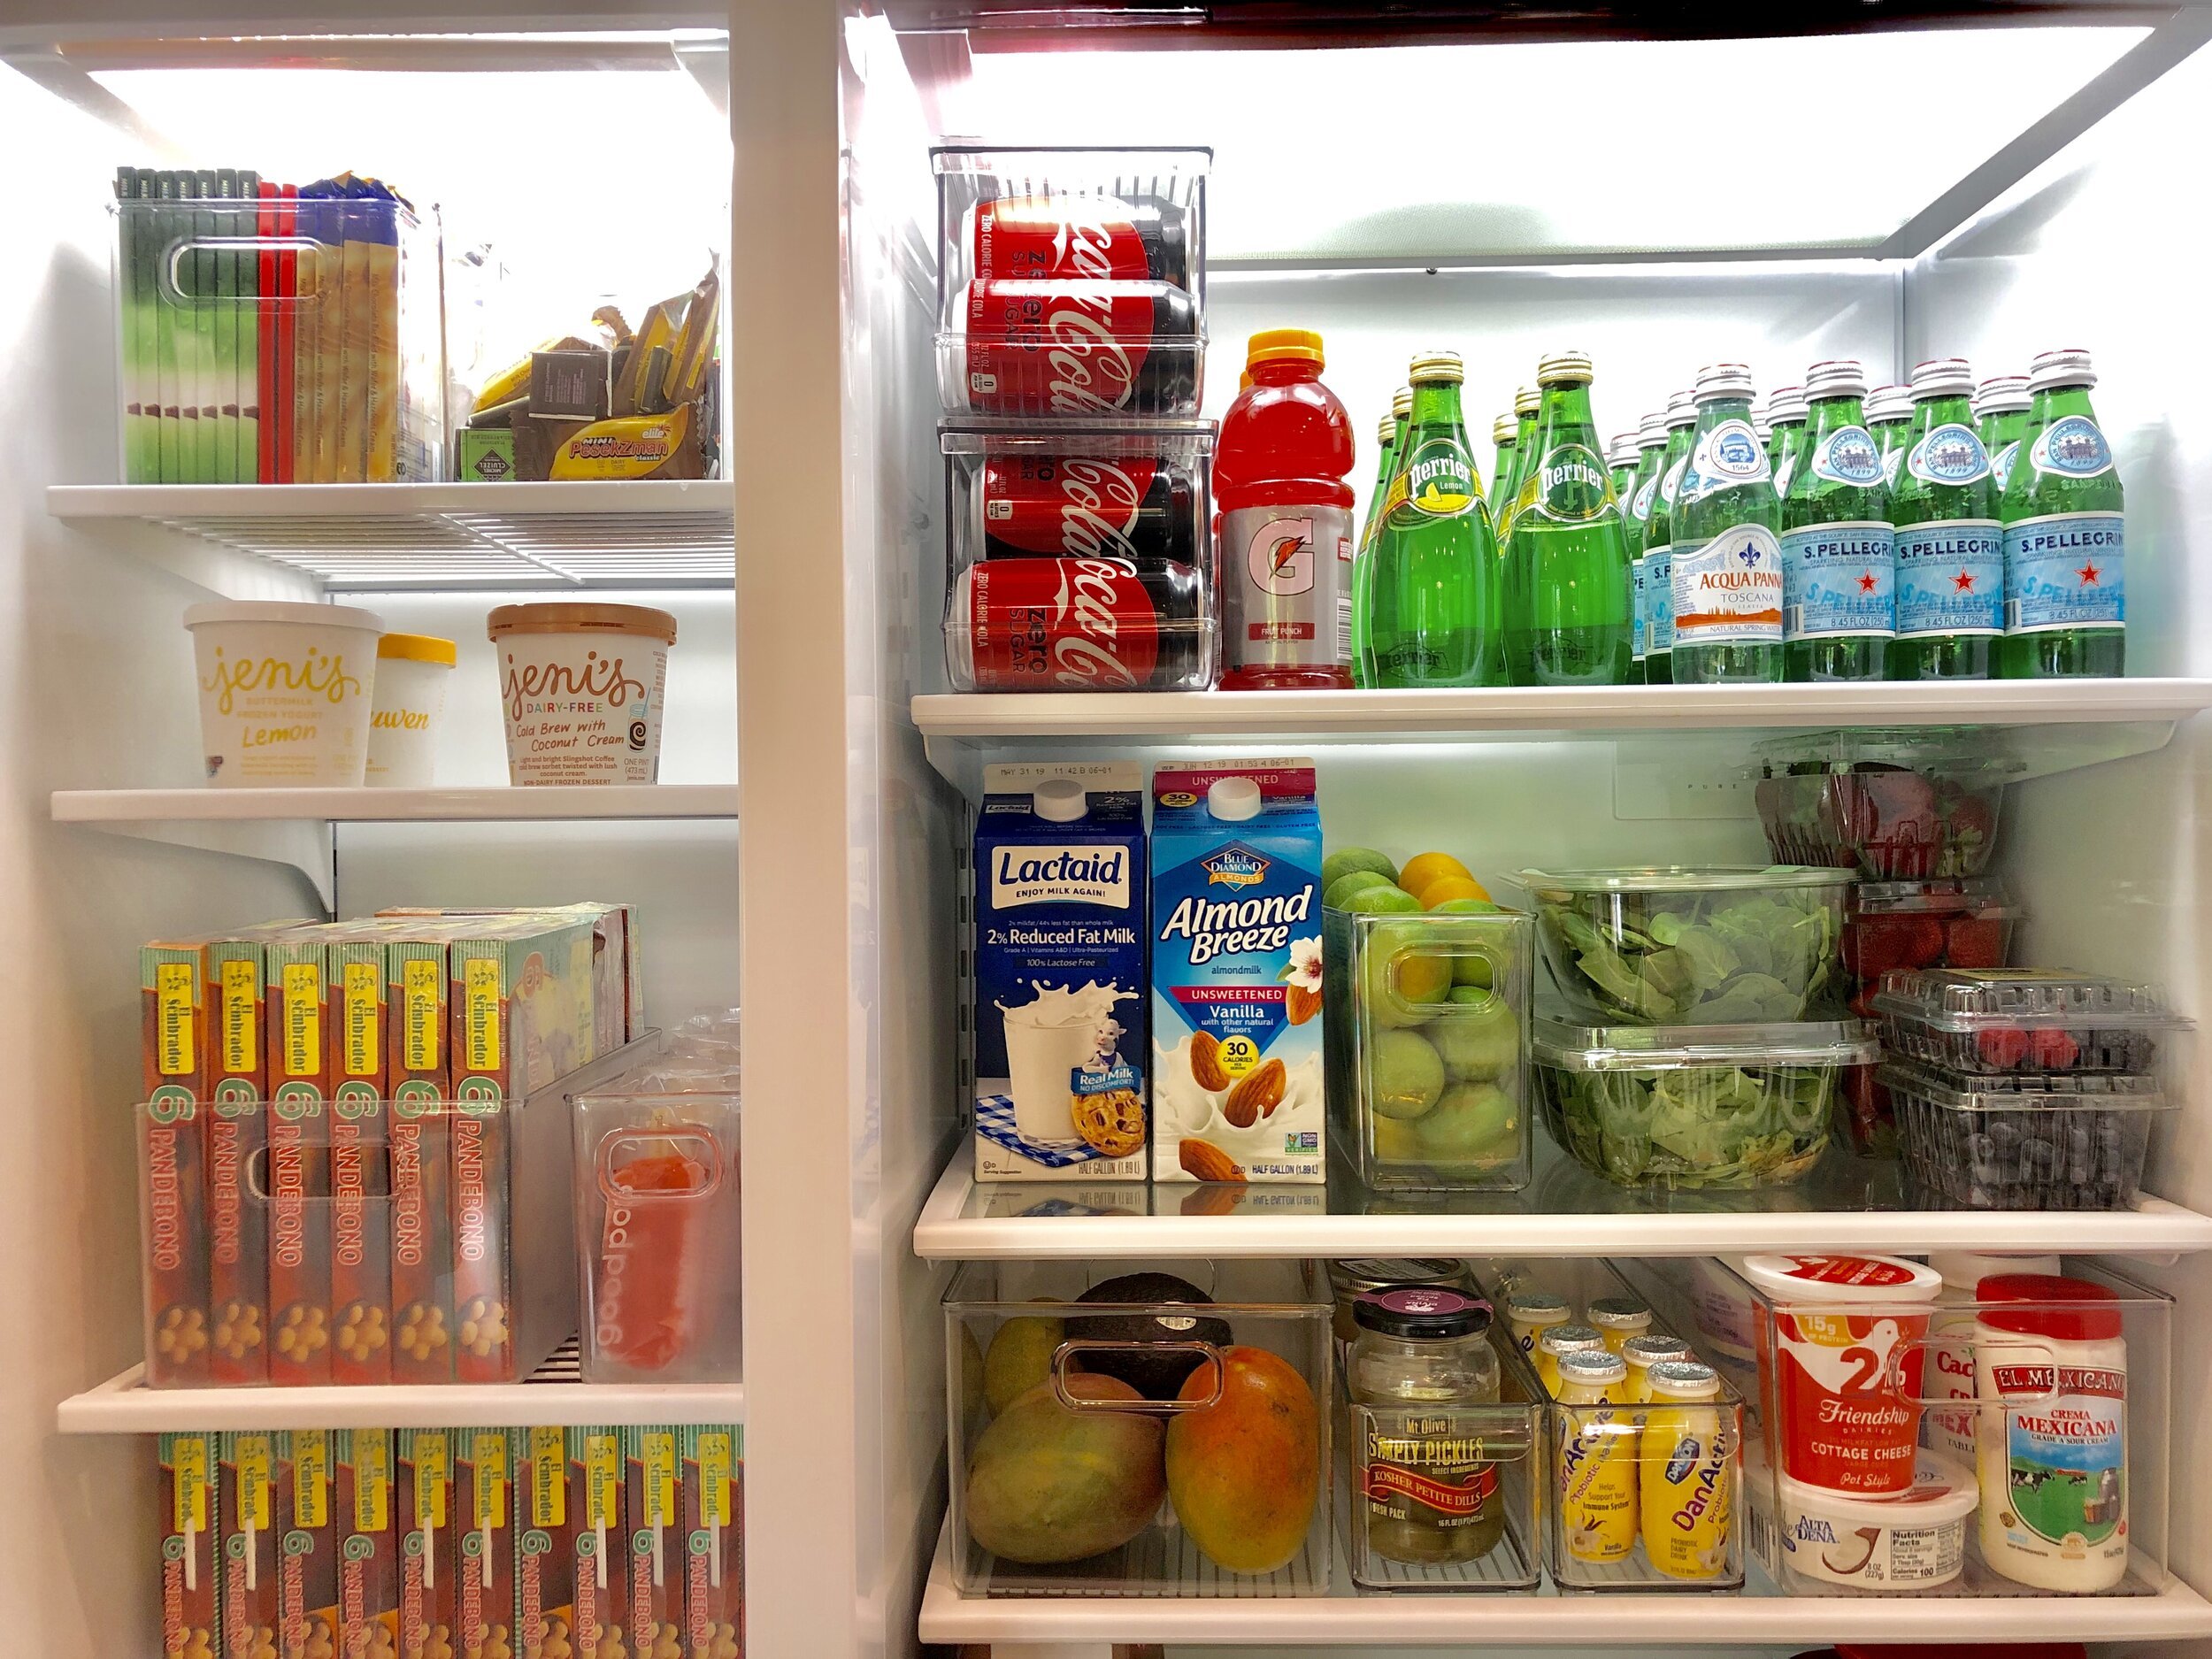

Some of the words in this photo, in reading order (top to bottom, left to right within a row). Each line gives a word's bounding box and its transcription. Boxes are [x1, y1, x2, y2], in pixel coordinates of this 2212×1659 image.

[981, 215, 993, 233] ZERO
[981, 234, 992, 267] CALORIE
[1248, 518, 1315, 596] G
[977, 572, 989, 589] ZERO
[1700, 572, 1751, 590] ACQUA
[1754, 572, 1782, 588] PANN
[1721, 594, 1774, 603] TOSCANA
[1859, 616, 1870, 626] OZ
[977, 626, 989, 648] COLA
[1009, 608, 1025, 672] SUGAR
[1027, 608, 1048, 674] zero
[200, 646, 361, 715] jeni's
[503, 651, 645, 721] jeni's
[526, 703, 603, 714] DAIRY-FREE
[242, 726, 317, 749] Lemon
[516, 723, 535, 738] Cold
[541, 722, 571, 734] Brew
[577, 719, 606, 733] with
[531, 737, 579, 752] Coconut
[588, 736, 625, 747] Cream
[1210, 863, 1262, 872] DIAMOND
[1224, 854, 1249, 864] BLUE
[999, 851, 1122, 886] Lactaid
[1213, 873, 1261, 883] ALMONDS
[1016, 888, 1044, 898] ENJOY
[1073, 888, 1106, 897] AGAIN!
[1160, 885, 1313, 940] Almond
[987, 929, 1008, 945] 2%
[1010, 928, 1074, 944] Reduced
[1078, 929, 1101, 944] Fat
[1104, 928, 1135, 943] Milk
[1190, 926, 1288, 964] Breeze
[1048, 958, 1078, 967] Lactose
[1211, 965, 1262, 975] almondmilk
[1191, 989, 1282, 1000] UNSWEETENED
[1210, 1005, 1264, 1018] Vanilla
[165, 998, 180, 1071] Sembrador
[229, 995, 243, 1069] Sembrador
[290, 998, 306, 1071] Sembrador
[411, 994, 426, 1069] Sembrador
[472, 994, 488, 1068] Sembrador
[1226, 1042, 1248, 1056] 30
[1079, 1074, 1106, 1086] Real
[1108, 1068, 1133, 1079] Milk
[1079, 1161, 1092, 1175] HALF
[1093, 1161, 1116, 1175] GALLON
[275, 1125, 303, 1267] PANDEBONO
[334, 1125, 363, 1266] PANDEBONO
[457, 1120, 485, 1261] PANDEBONO
[2001, 1370, 2025, 1387] EL
[1819, 1400, 1909, 1427] Friendship
[2050, 1409, 2092, 1420] CREMA
[1422, 1418, 1446, 1434] Olive
[2017, 1415, 2117, 1437] MEXICANA
[2032, 1433, 2057, 1443] GRADE
[2066, 1437, 2086, 1446] SOUR
[2086, 1437, 2109, 1446] CREAM
[1425, 1437, 1484, 1465] PICKLES
[1811, 1441, 1869, 1460] COTTAGE
[1874, 1444, 1911, 1460] CHEESE
[1374, 1471, 1413, 1489] KOSHER
[1416, 1482, 1453, 1504] PETITE
[1455, 1492, 1480, 1506] DILLS
[1840, 1472, 1861, 1486] Pot
[1863, 1473, 1891, 1487] Style
[1588, 1492, 1613, 1502] Support
[1610, 1501, 1629, 1509] System
[1389, 1508, 1406, 1520] PACK
[1800, 1515, 1833, 1532] ALTA
[1797, 1529, 1836, 1544] DENA
[1920, 1567, 1934, 1577] 100
